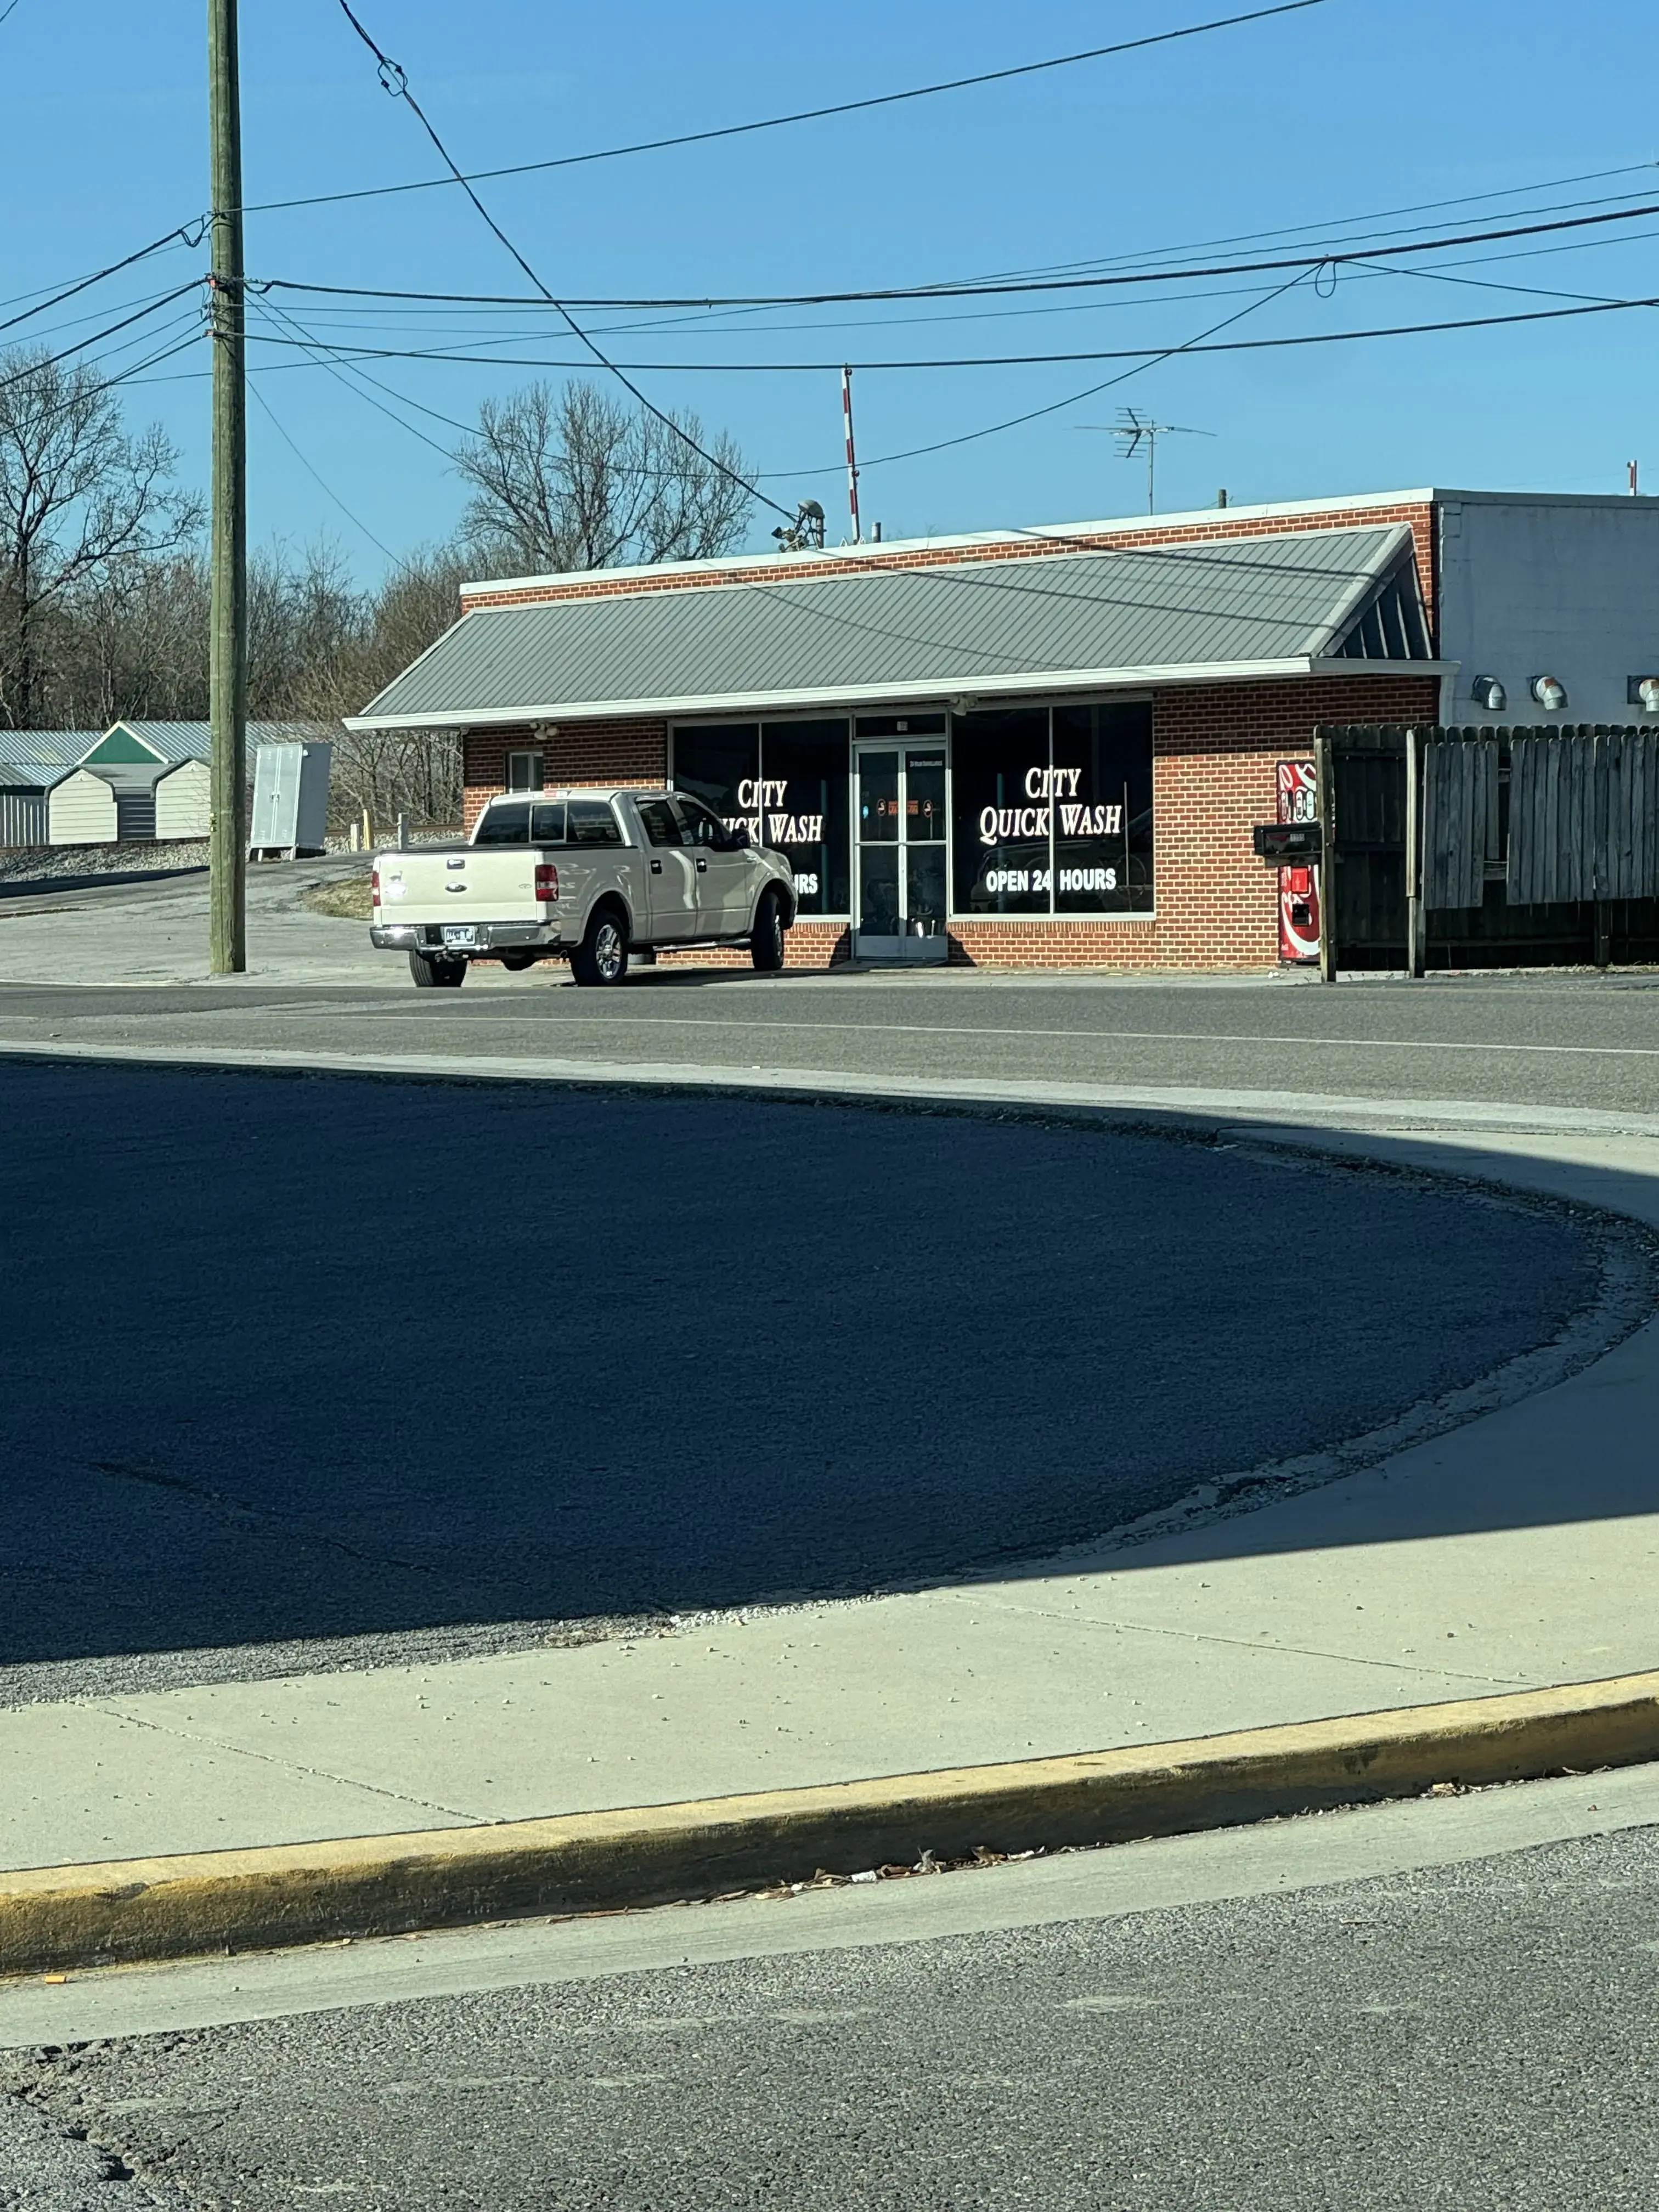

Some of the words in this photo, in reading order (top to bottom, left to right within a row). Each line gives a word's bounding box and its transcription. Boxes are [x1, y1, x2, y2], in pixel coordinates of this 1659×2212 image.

[738, 779, 787, 808] CITY
[1025, 768, 1081, 798] CITY
[768, 814, 823, 843] WASH
[980, 806, 1050, 845] QUICK
[1059, 804, 1122, 836] WASH
[986, 870, 1029, 891] OPEN
[1032, 870, 1051, 891] 24
[1059, 868, 1116, 891] HOURS
